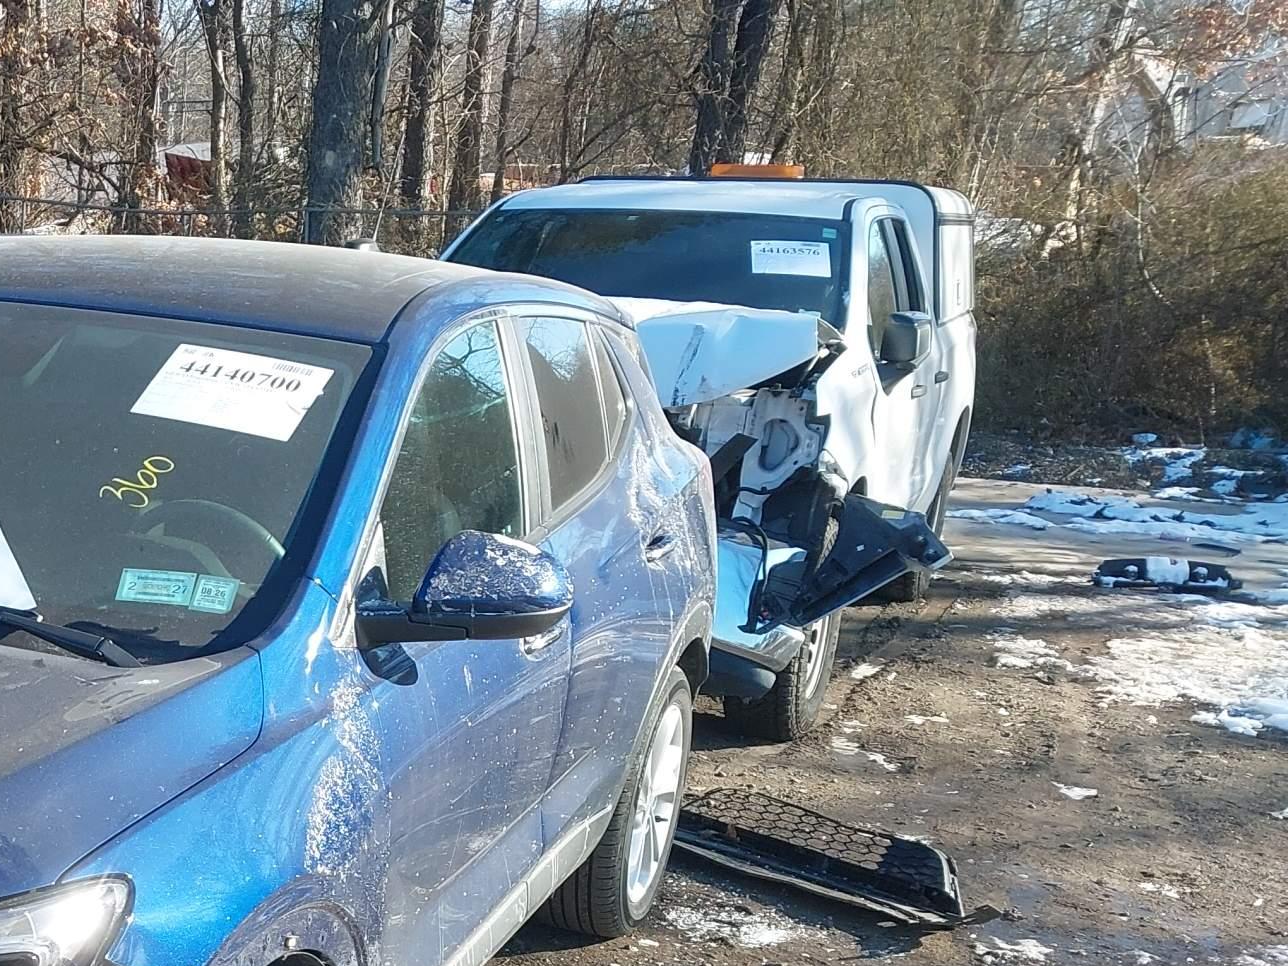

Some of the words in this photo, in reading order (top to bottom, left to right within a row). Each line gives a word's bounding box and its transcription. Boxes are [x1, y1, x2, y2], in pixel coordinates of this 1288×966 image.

[759, 246, 821, 256] 44163576
[179, 360, 302, 393] 44140700
[99, 455, 175, 508] 360
